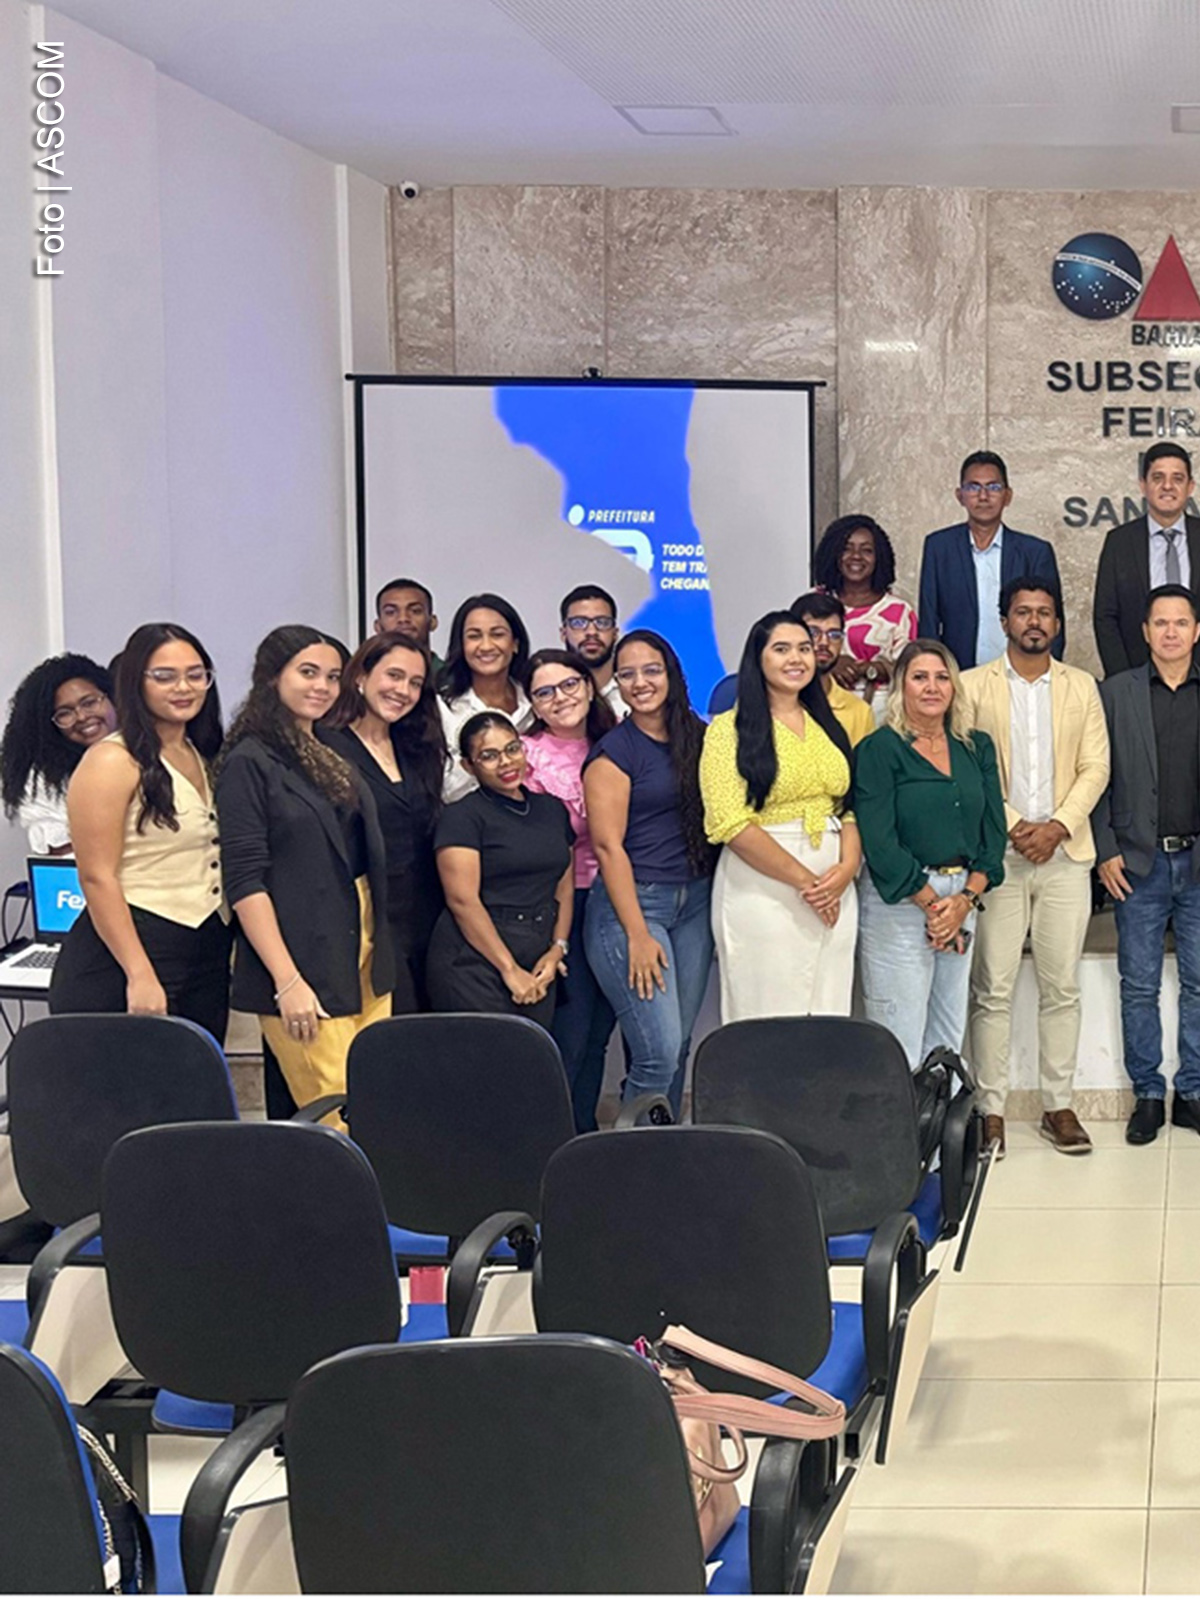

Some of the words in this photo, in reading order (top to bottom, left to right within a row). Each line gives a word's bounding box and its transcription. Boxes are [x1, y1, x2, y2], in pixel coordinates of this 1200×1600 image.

[588, 509, 656, 523] PREFEITURA
[662, 544, 694, 557] TODO
[662, 561, 687, 573] TEM
